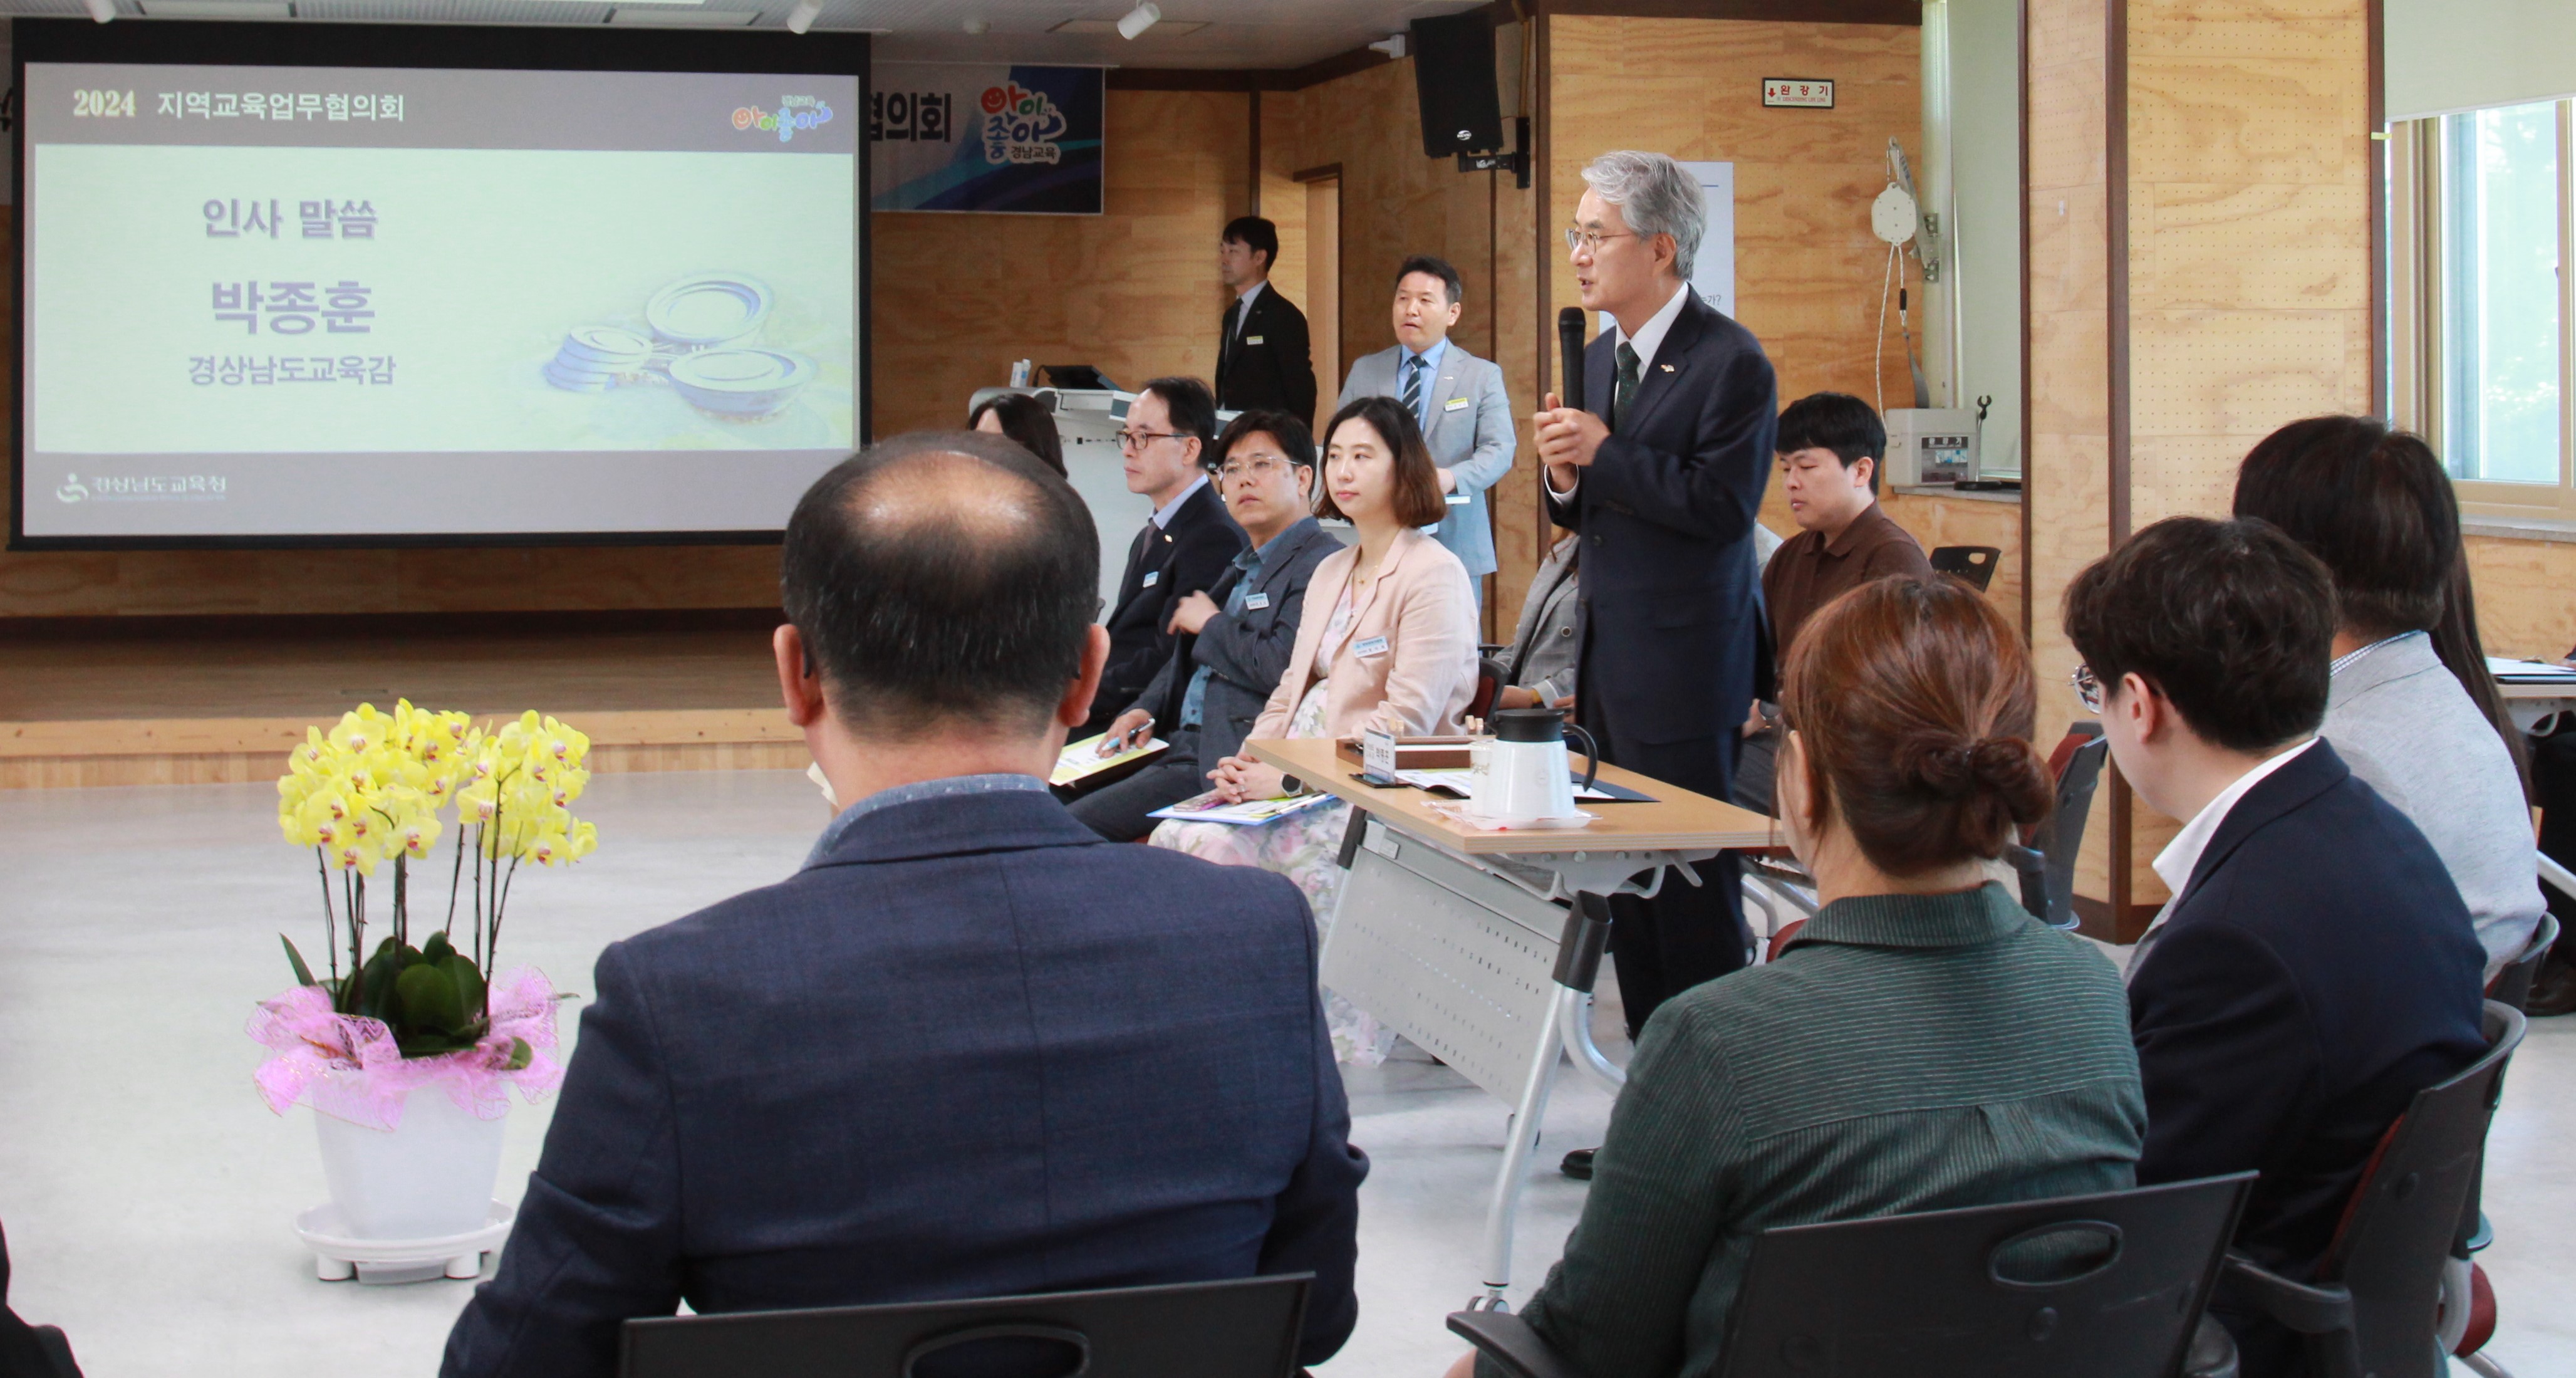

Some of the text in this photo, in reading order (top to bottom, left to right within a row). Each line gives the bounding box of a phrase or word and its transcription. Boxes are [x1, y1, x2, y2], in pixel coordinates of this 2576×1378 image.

[73, 89, 404, 122] 2024 지역교육업무협의회
[1011, 145, 1057, 160] 경남교육
[203, 198, 378, 240] 인사 말씀
[212, 280, 375, 335] 박종훈
[189, 355, 396, 385] 경상남도교육감
